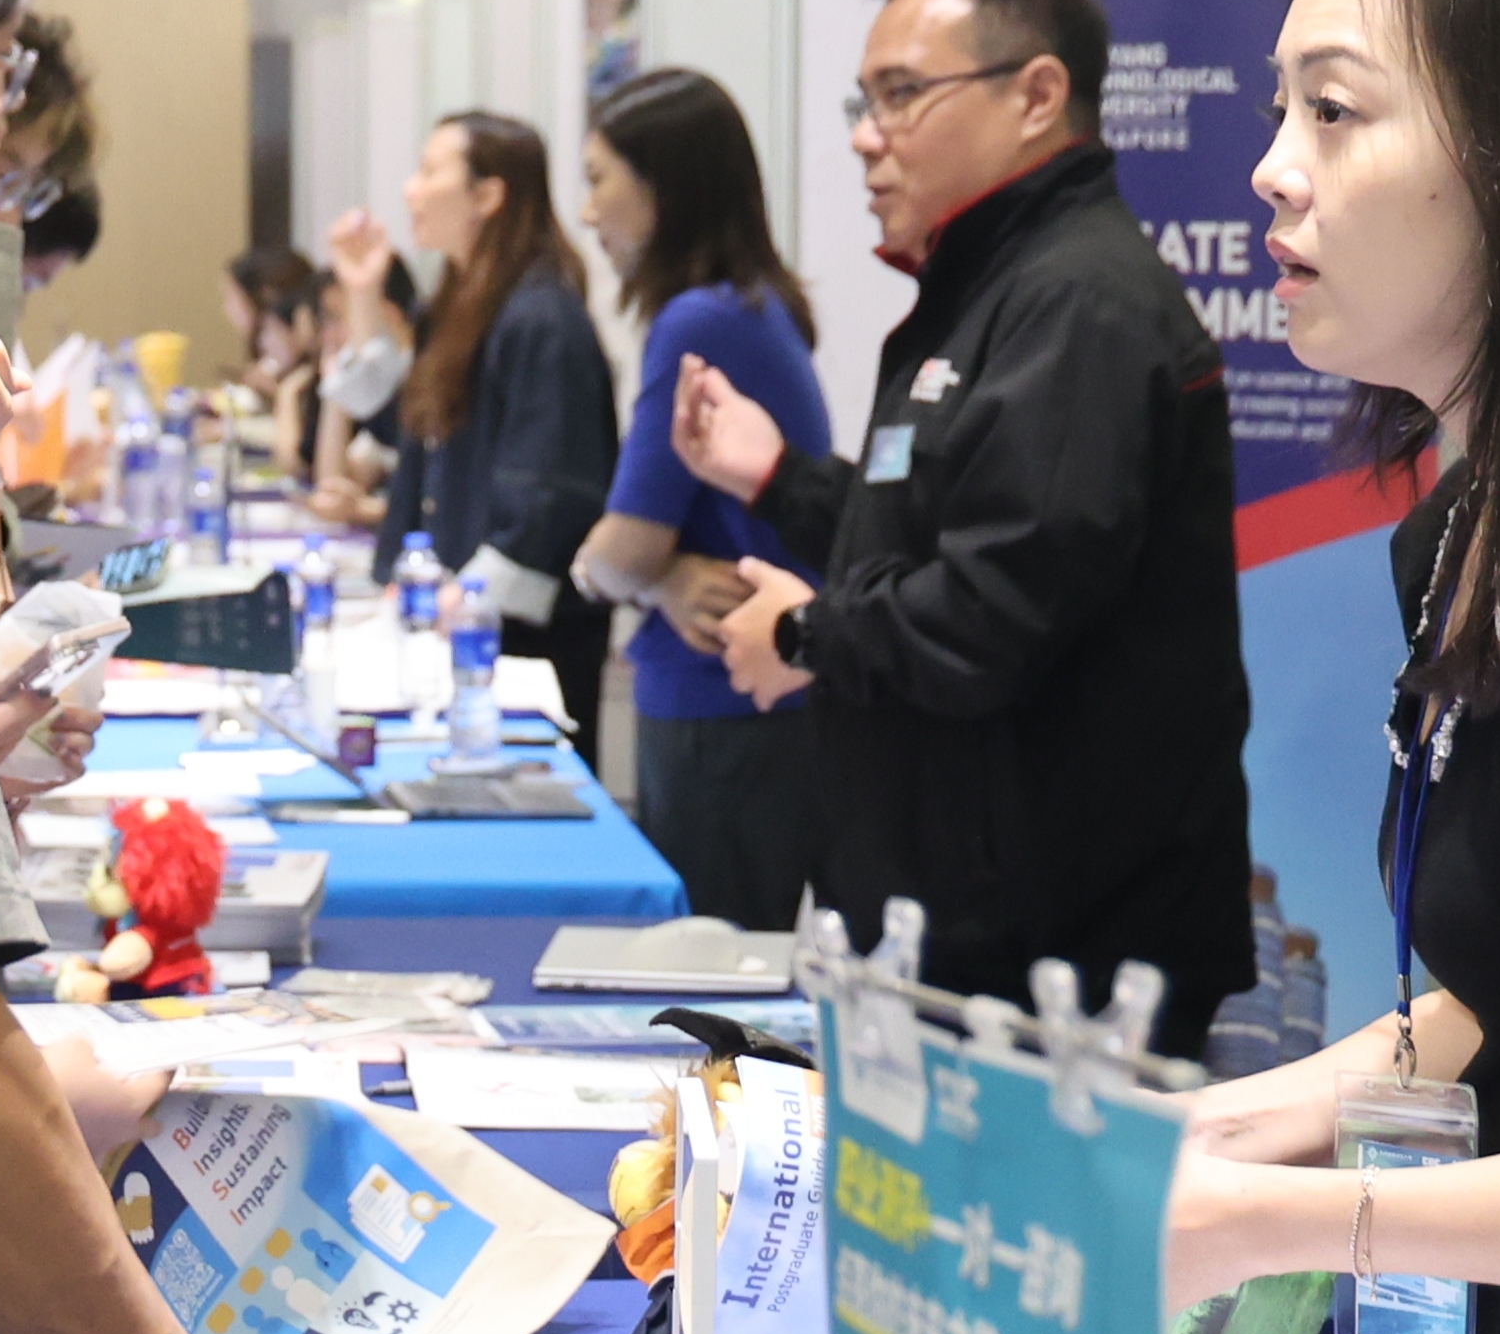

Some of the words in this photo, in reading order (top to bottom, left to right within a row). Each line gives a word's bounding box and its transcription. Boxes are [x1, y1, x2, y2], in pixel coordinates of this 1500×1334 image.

[1108, 41, 1168, 68] YANG
[1138, 220, 1252, 276] ATE
[212, 1103, 292, 1202] Sustaining
[230, 1155, 288, 1226] Impact
[722, 1087, 804, 1310] International
[767, 1209, 819, 1314] Postgraduate
